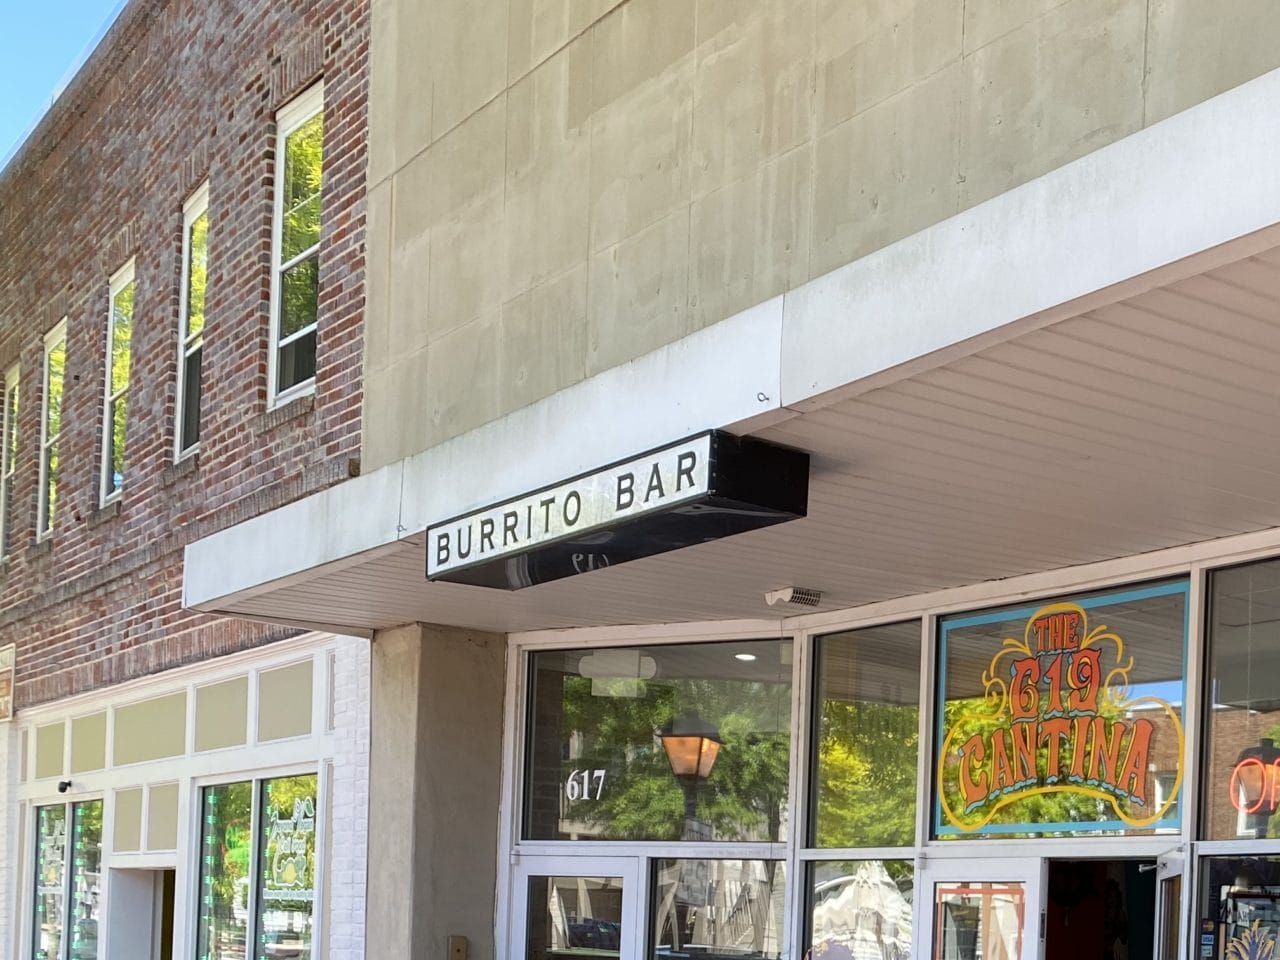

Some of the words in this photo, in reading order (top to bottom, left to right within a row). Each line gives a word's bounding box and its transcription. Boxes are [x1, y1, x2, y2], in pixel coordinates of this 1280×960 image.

[436, 490, 582, 566] BURRITO
[615, 450, 698, 512] BAR
[1034, 612, 1080, 655] THE
[1010, 647, 1102, 725] 619
[566, 769, 606, 801] 617
[959, 715, 1153, 816] CANTINA
